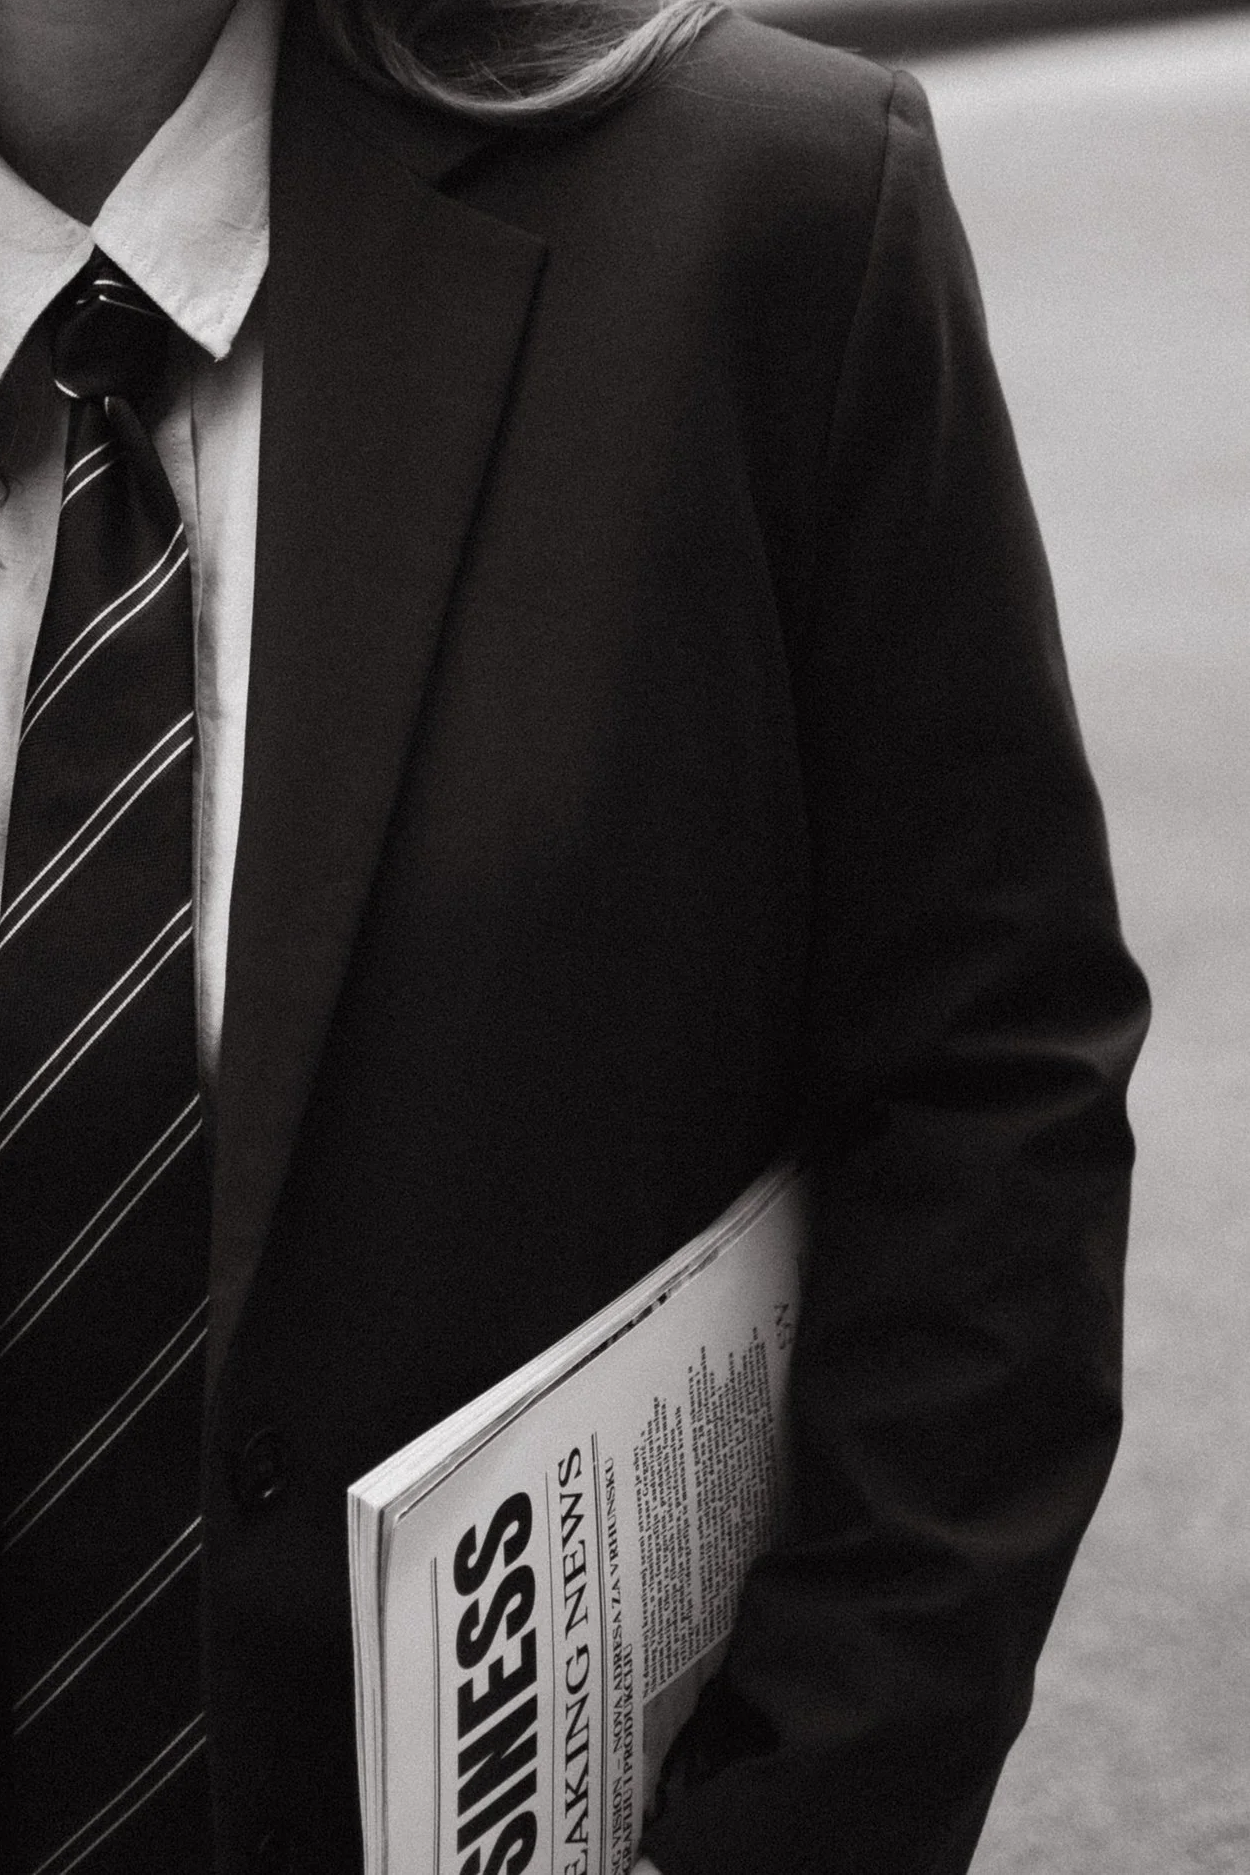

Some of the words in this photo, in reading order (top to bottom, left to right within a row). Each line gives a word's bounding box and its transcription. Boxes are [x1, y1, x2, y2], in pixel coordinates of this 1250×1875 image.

[558, 1447, 588, 1640] NEWS
[605, 1457, 618, 1577] VRHUNSKU
[611, 1578, 621, 1609] ZA
[453, 1492, 537, 1875] SINESS
[612, 1611, 622, 1690] ADRESA
[612, 1696, 622, 1753] NOVA
[623, 1644, 632, 1773] PRODUKCIJU
[611, 1777, 622, 1848] VISION
